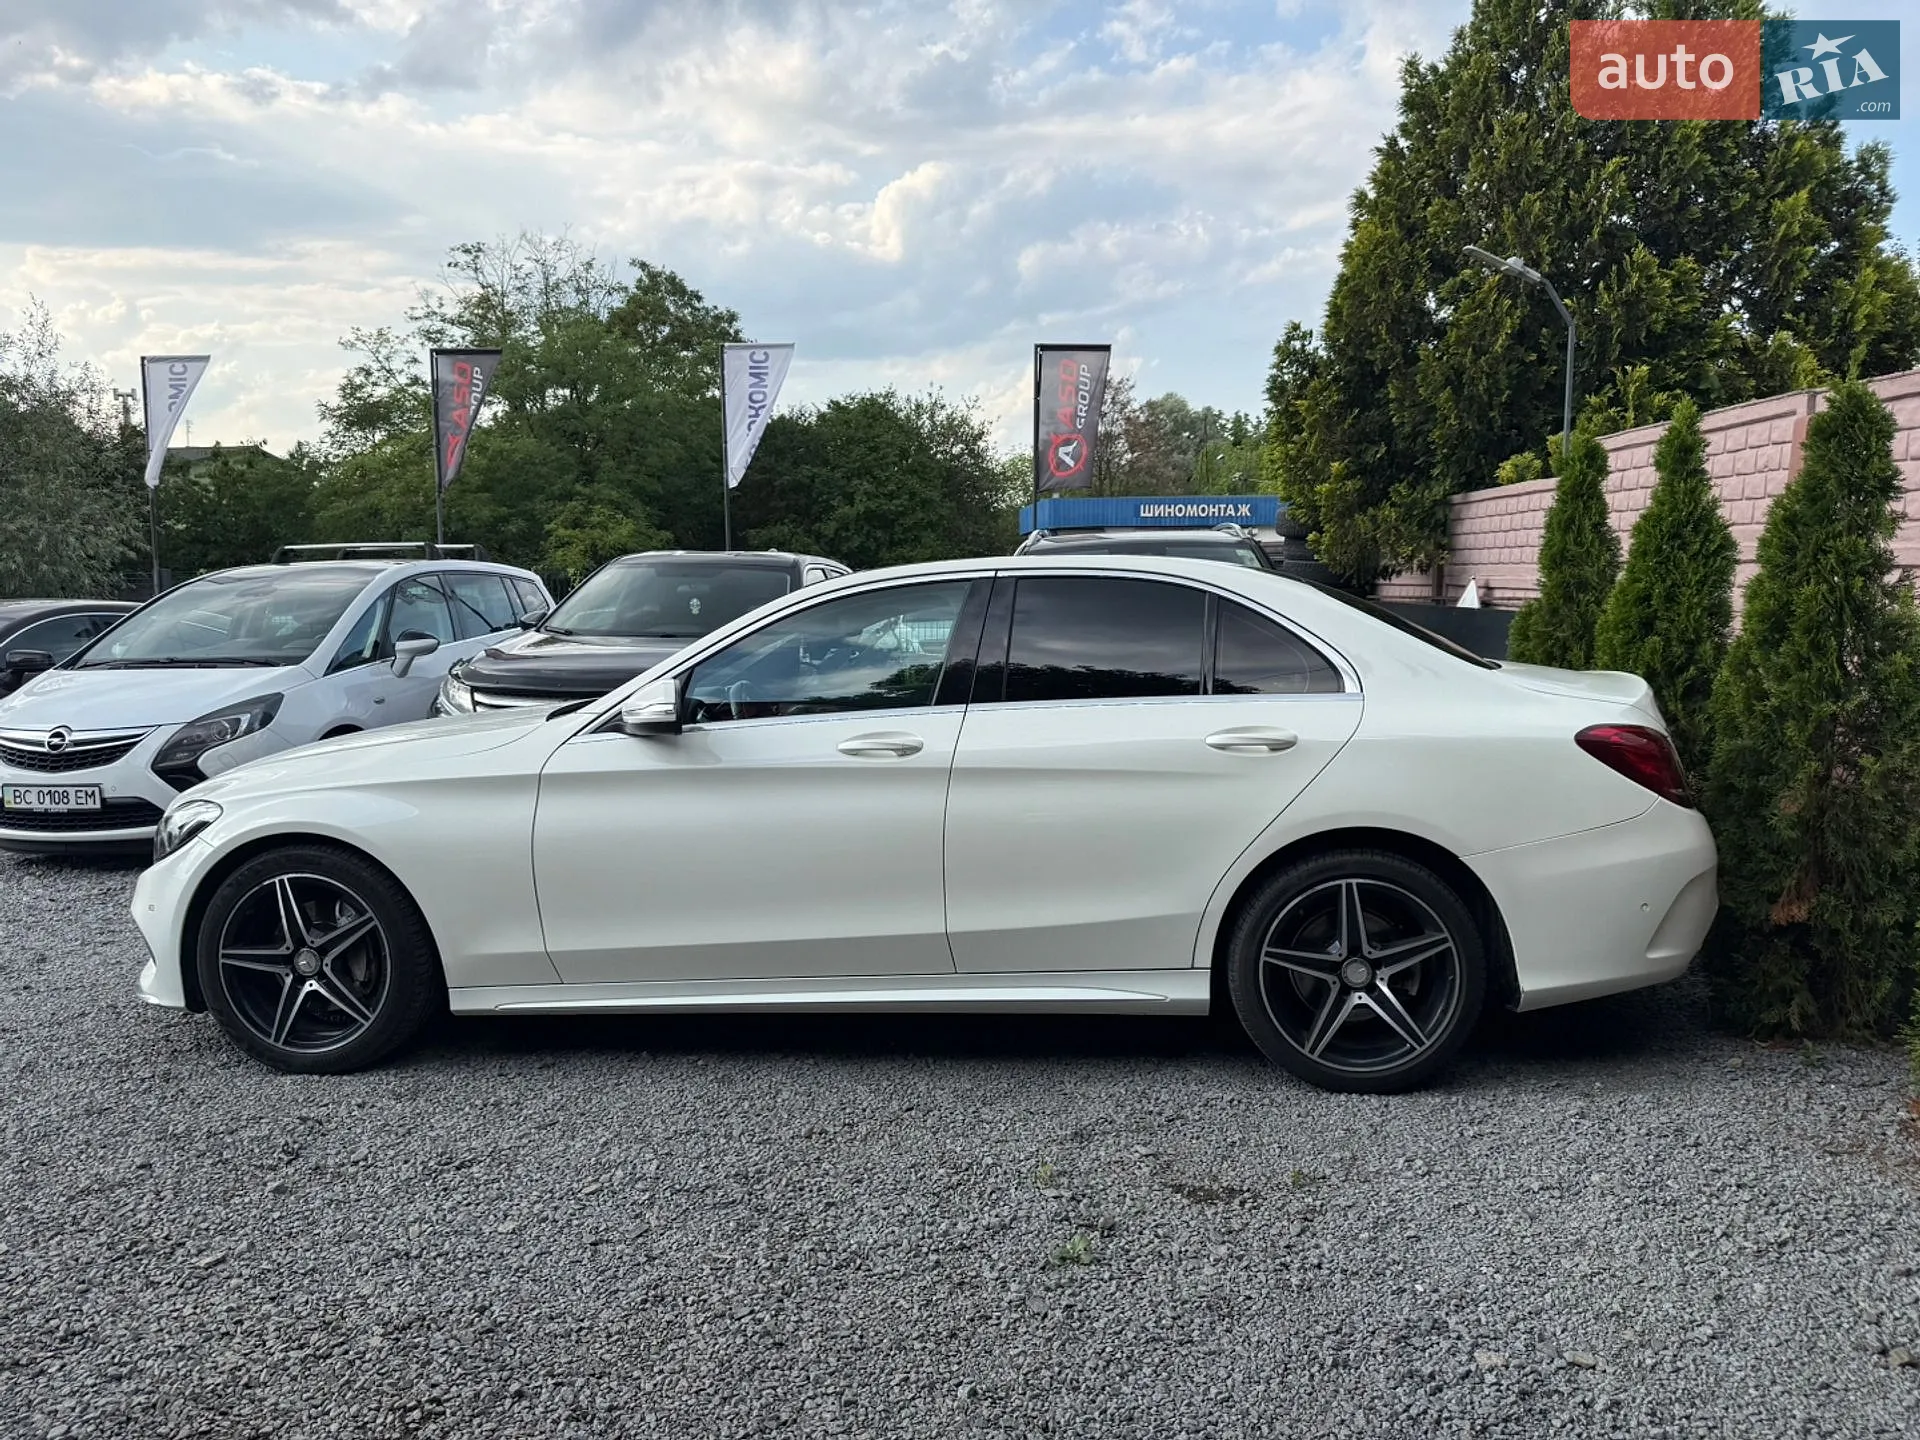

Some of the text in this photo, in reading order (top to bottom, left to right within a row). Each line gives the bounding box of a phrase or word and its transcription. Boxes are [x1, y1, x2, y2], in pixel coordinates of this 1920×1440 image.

[1076, 364, 1092, 429] GROUP
[1139, 503, 1251, 518] ШИНОМОНТАЖ
[13, 789, 97, 805] BC 0108 EM
